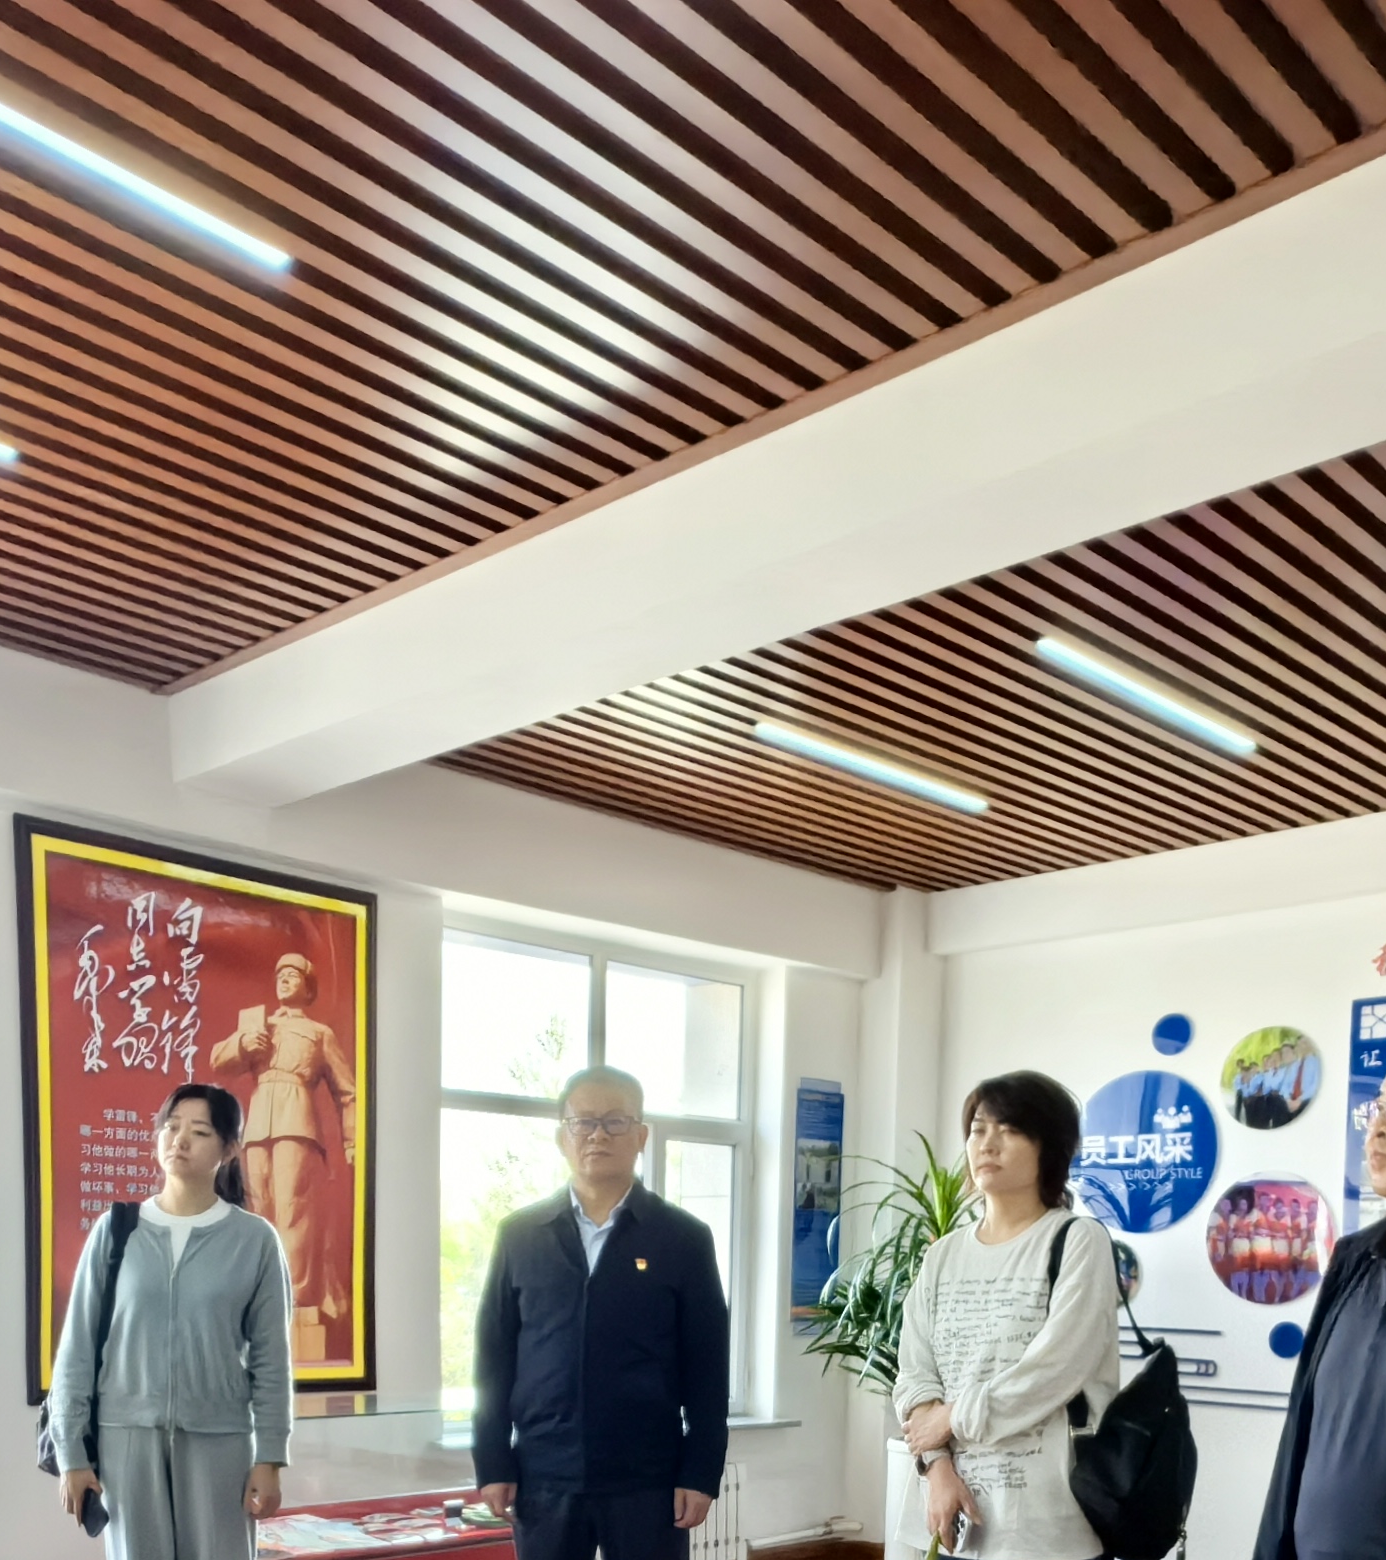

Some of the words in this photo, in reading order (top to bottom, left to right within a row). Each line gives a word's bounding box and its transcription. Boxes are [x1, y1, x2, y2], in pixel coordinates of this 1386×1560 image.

[1080, 1132, 1192, 1166] 员工风采
[1125, 1167, 1168, 1180] GROUP
[1170, 1166, 1204, 1179] STYLE
